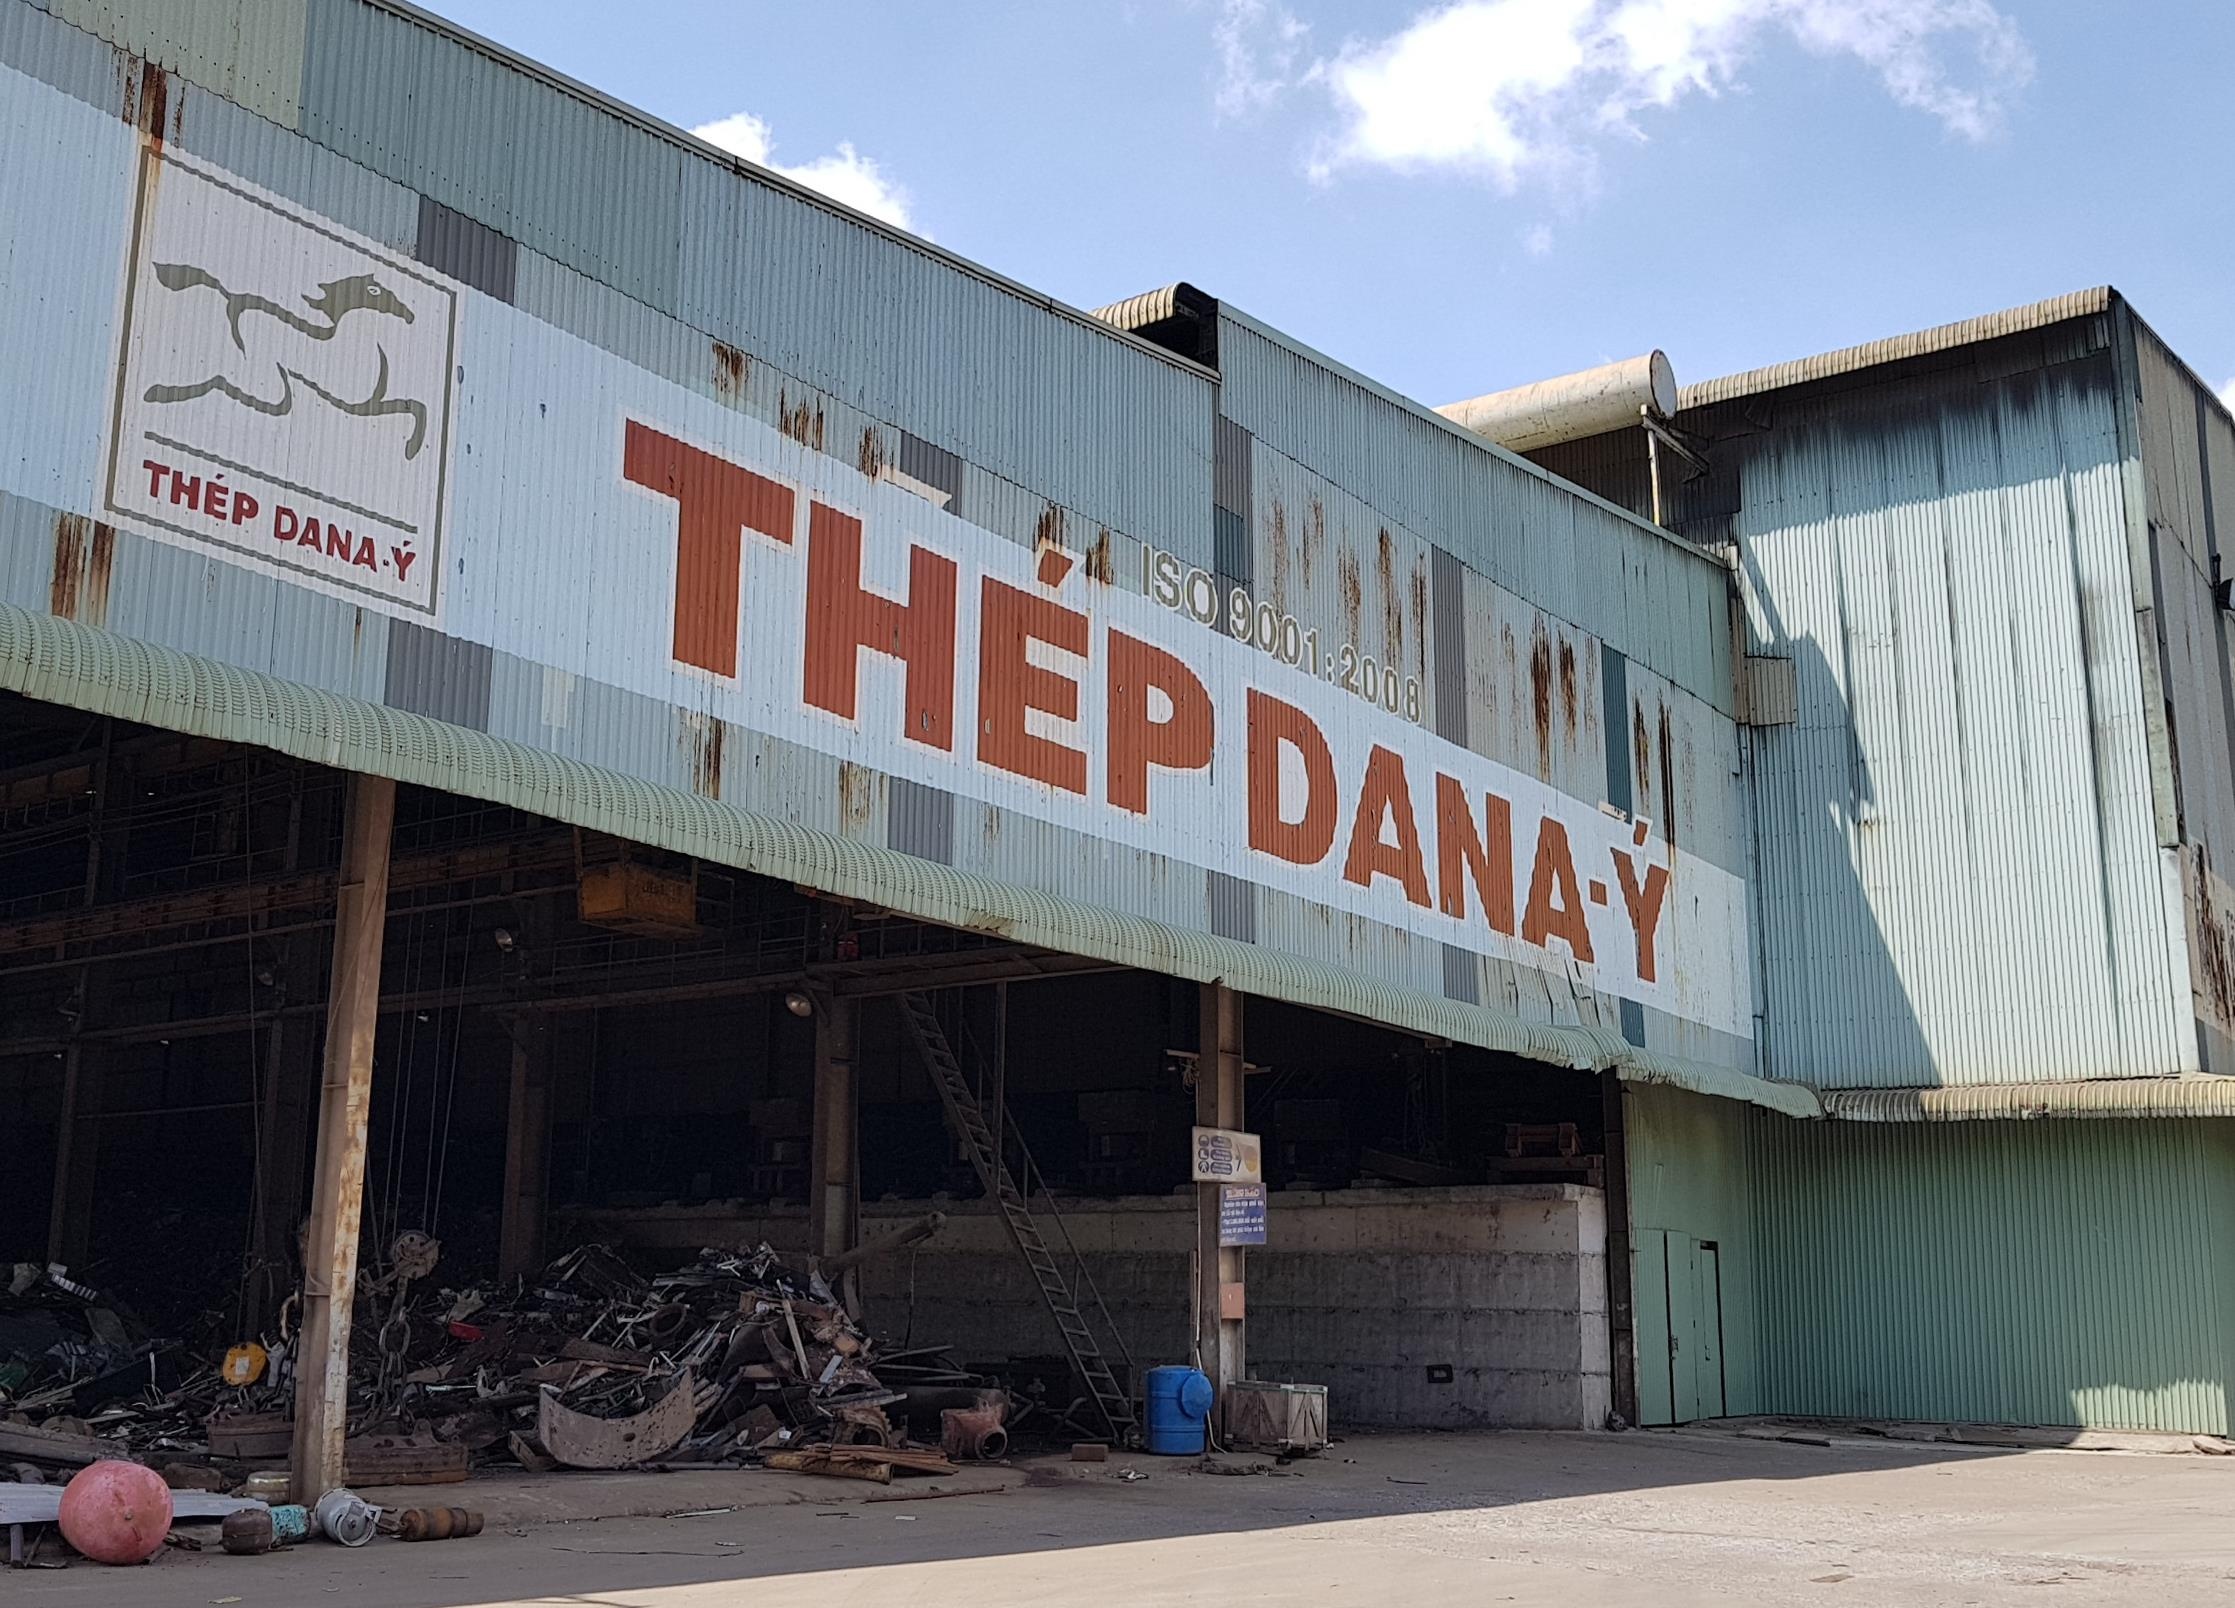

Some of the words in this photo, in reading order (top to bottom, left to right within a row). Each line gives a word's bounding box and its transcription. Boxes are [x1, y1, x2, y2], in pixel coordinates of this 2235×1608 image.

[143, 460, 259, 526] THÉP
[624, 417, 1215, 815] THÉP
[1247, 687, 1670, 983] DANA-Ý
[1142, 542, 1218, 628] ISO
[1229, 586, 1422, 724] 9001:2008
